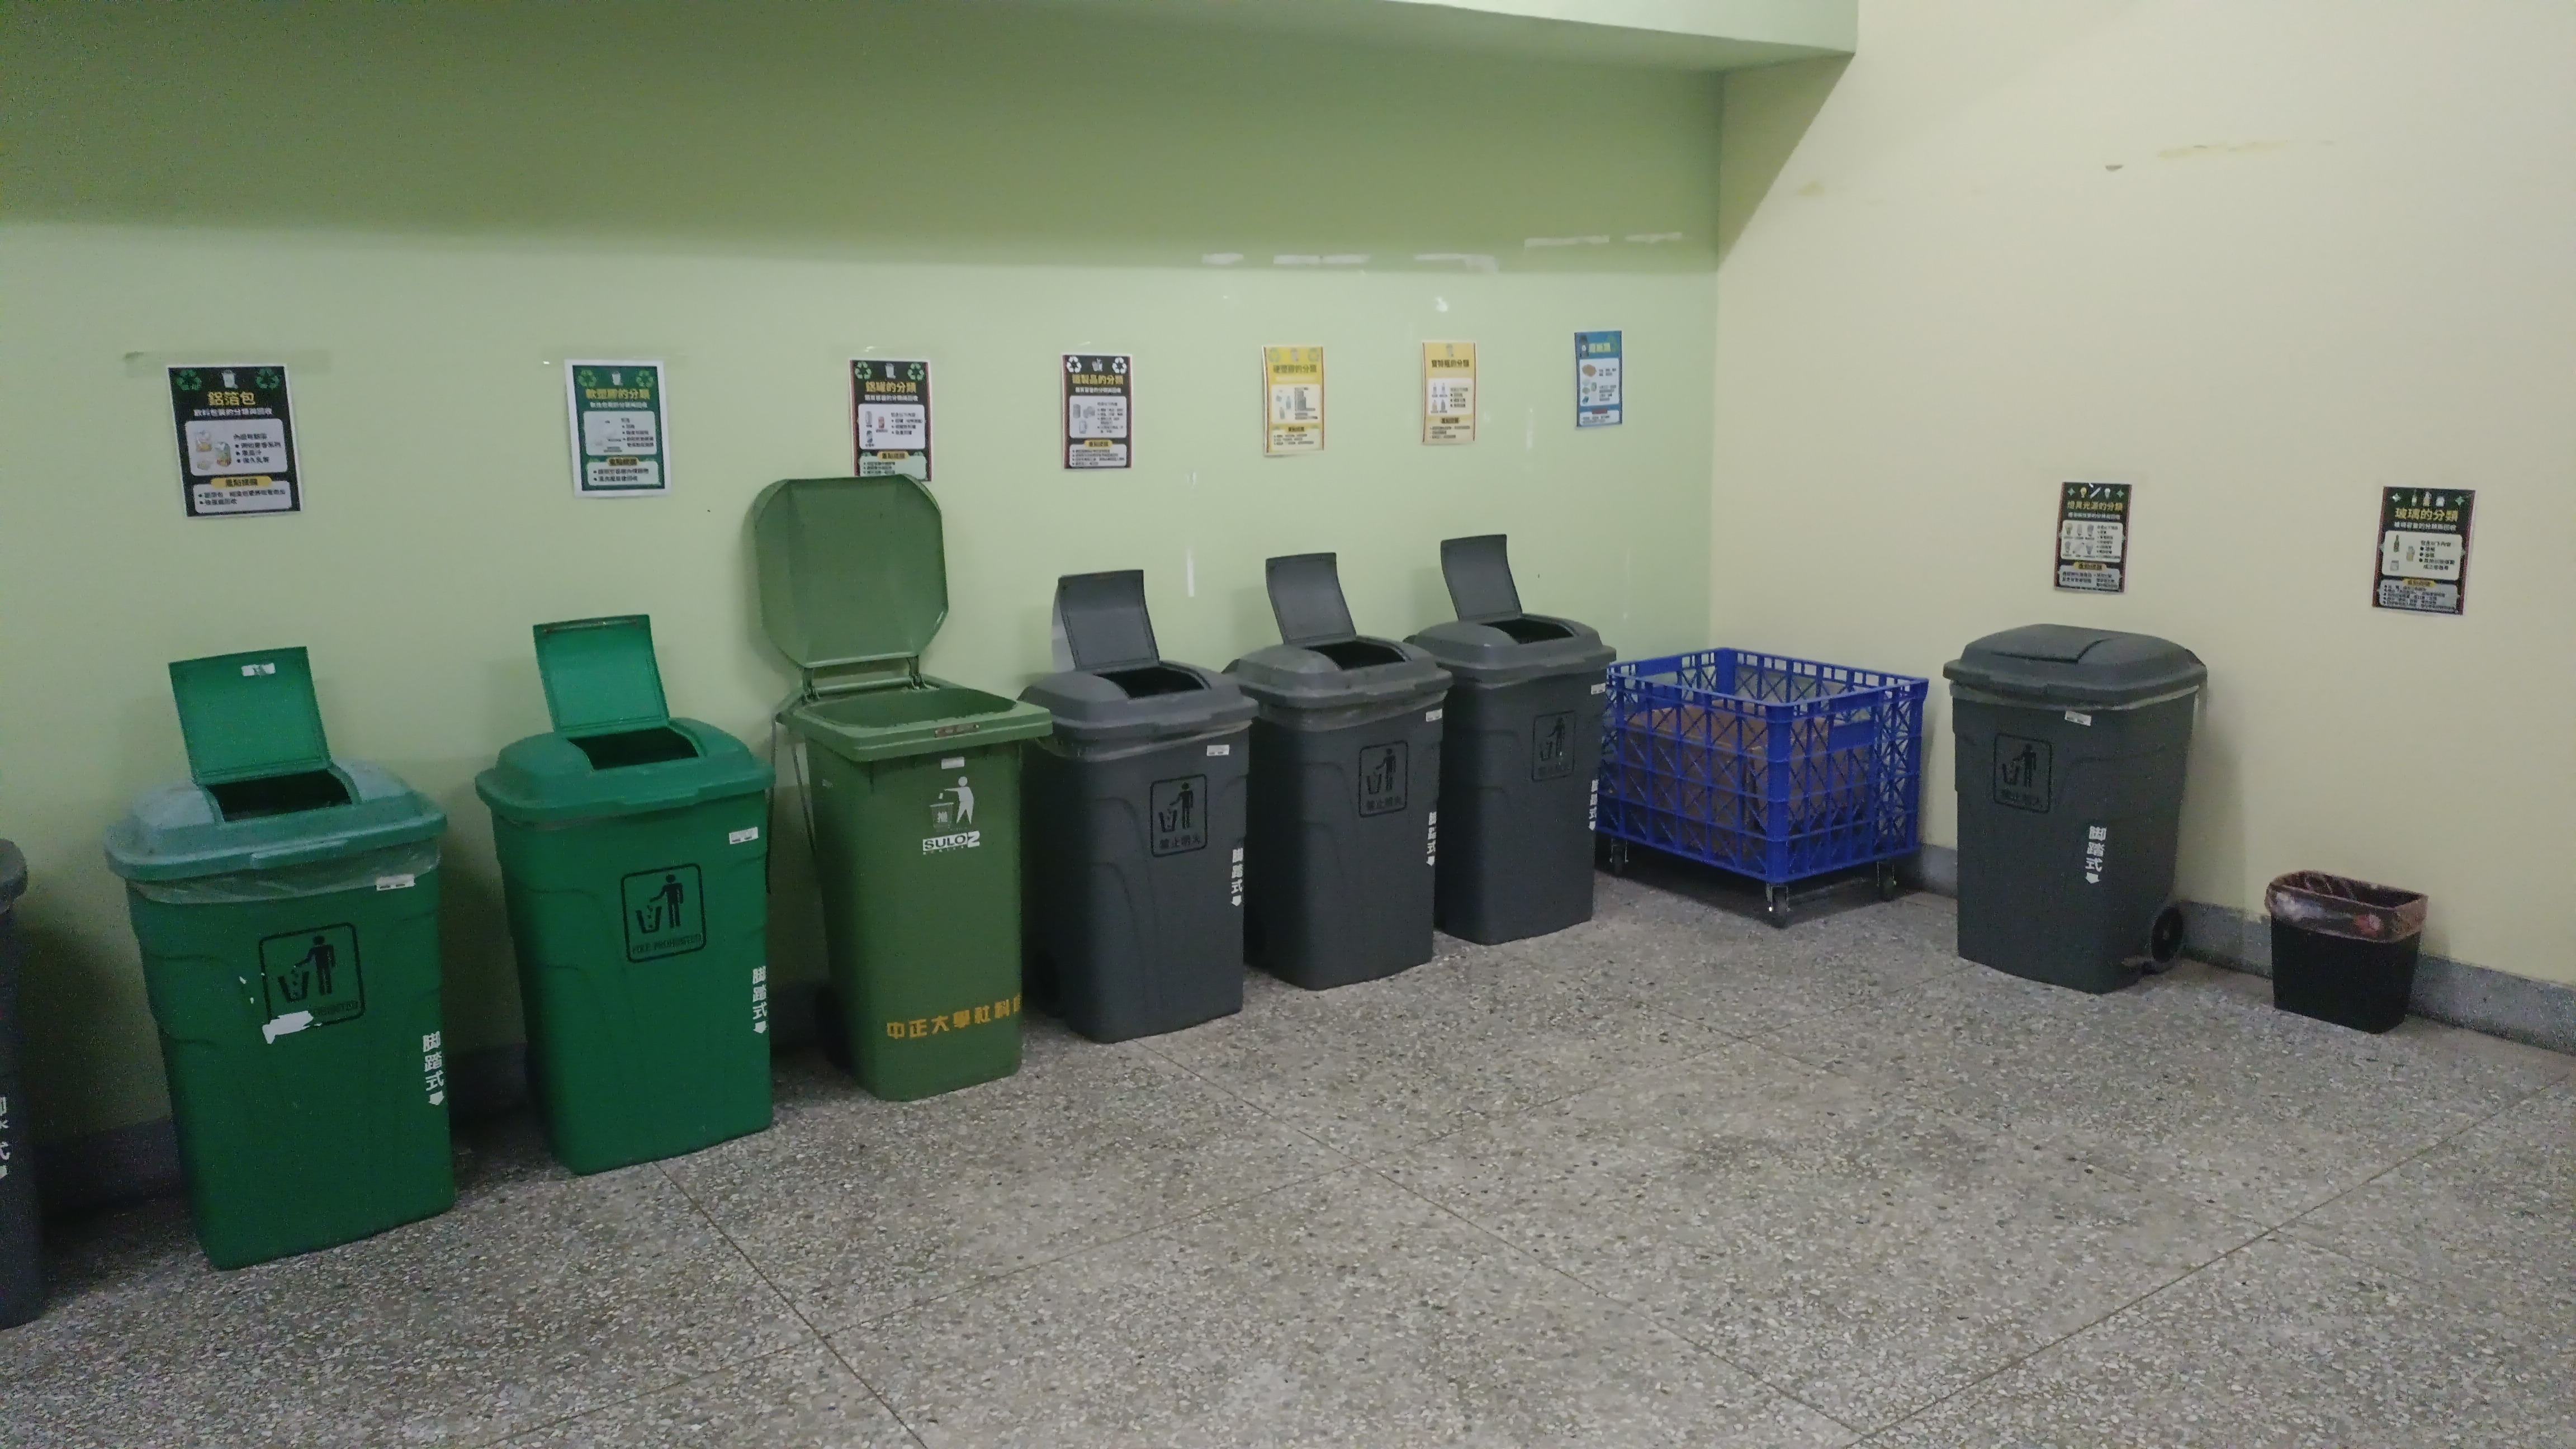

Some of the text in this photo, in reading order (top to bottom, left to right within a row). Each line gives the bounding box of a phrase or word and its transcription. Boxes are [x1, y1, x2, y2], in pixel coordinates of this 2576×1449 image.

[865, 381, 917, 393] 鋁罐的分類
[207, 391, 256, 406] 鋁箔包
[2395, 507, 2459, 522] 玻璃的分類
